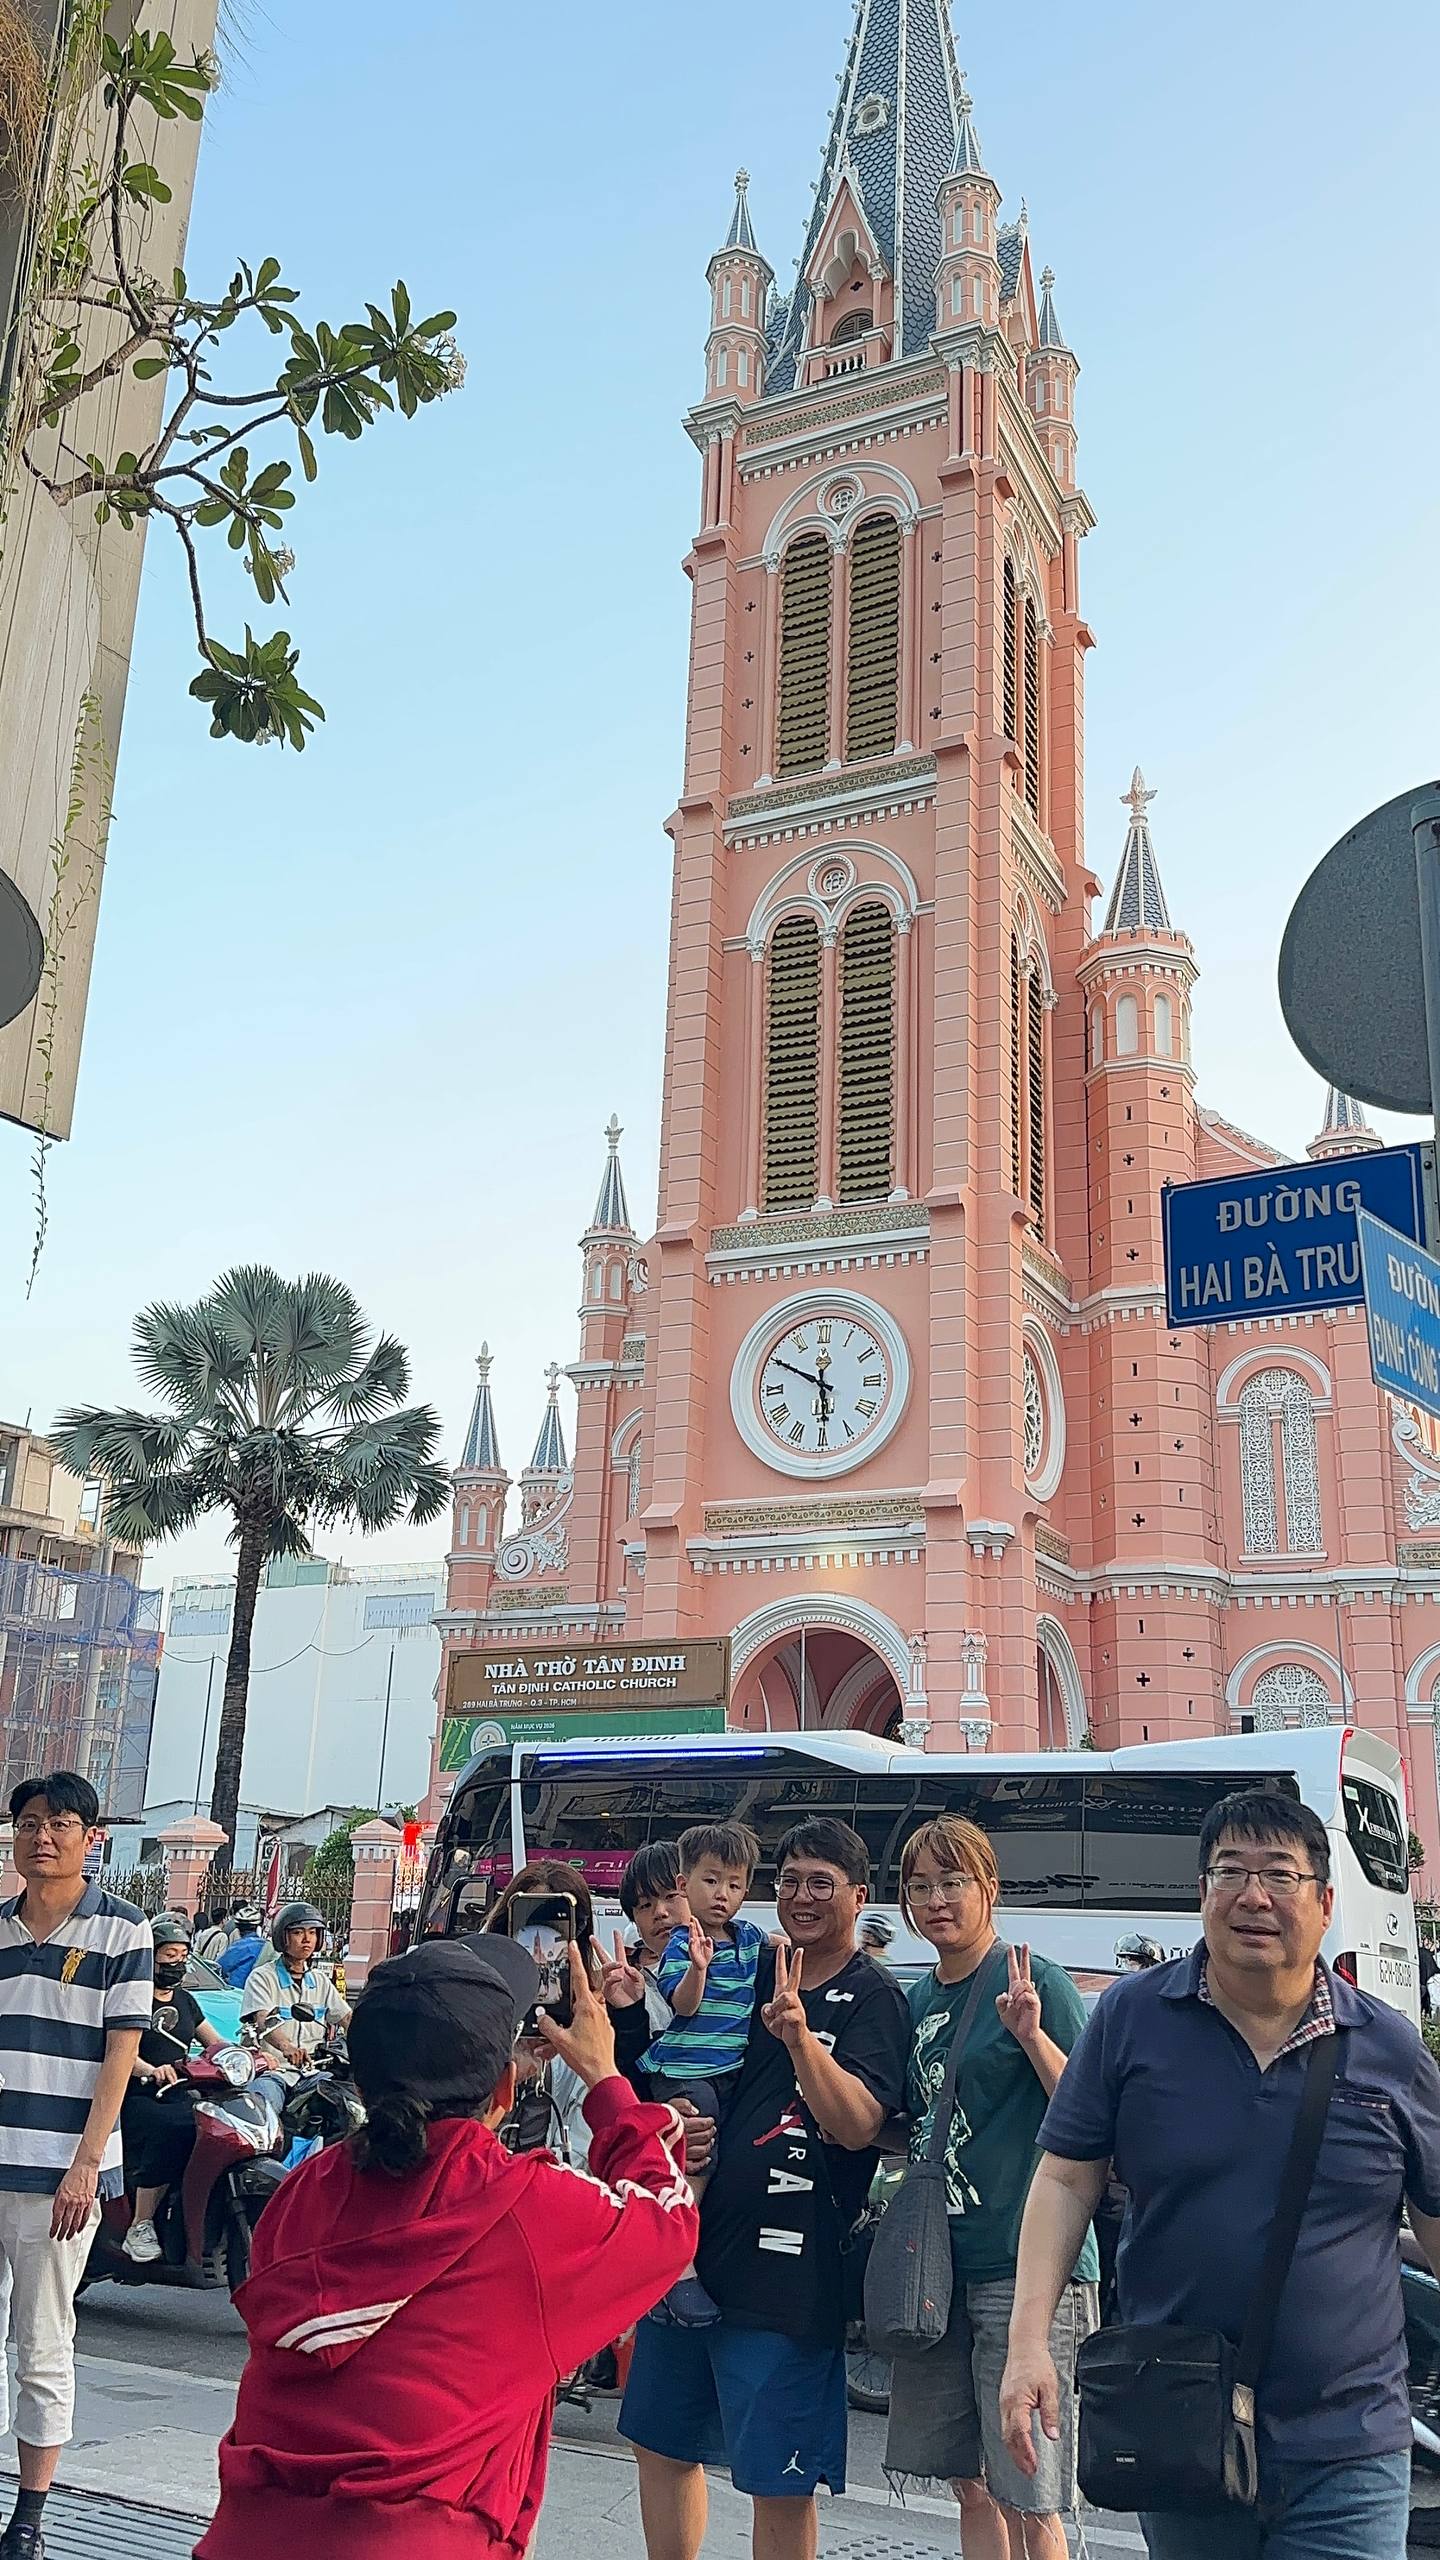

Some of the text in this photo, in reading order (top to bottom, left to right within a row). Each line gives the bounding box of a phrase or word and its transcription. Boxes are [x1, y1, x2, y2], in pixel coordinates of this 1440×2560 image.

[1216, 1181, 1361, 1233] ĐƯỜNG
[1179, 1259, 1233, 1308] HAI
[1243, 1241, 1289, 1300] BÀ
[484, 1655, 687, 1679] NHÀ THỜ TÂN ĐỊNH
[491, 1677, 677, 1695] TÂN ĐỊNH CATHOLIC CHURCH
[476, 1700, 488, 1708] HAI
[488, 1698, 498, 1708] BÀ
[499, 1699, 523, 1708] TRƯNG
[560, 1698, 577, 1706] HCM
